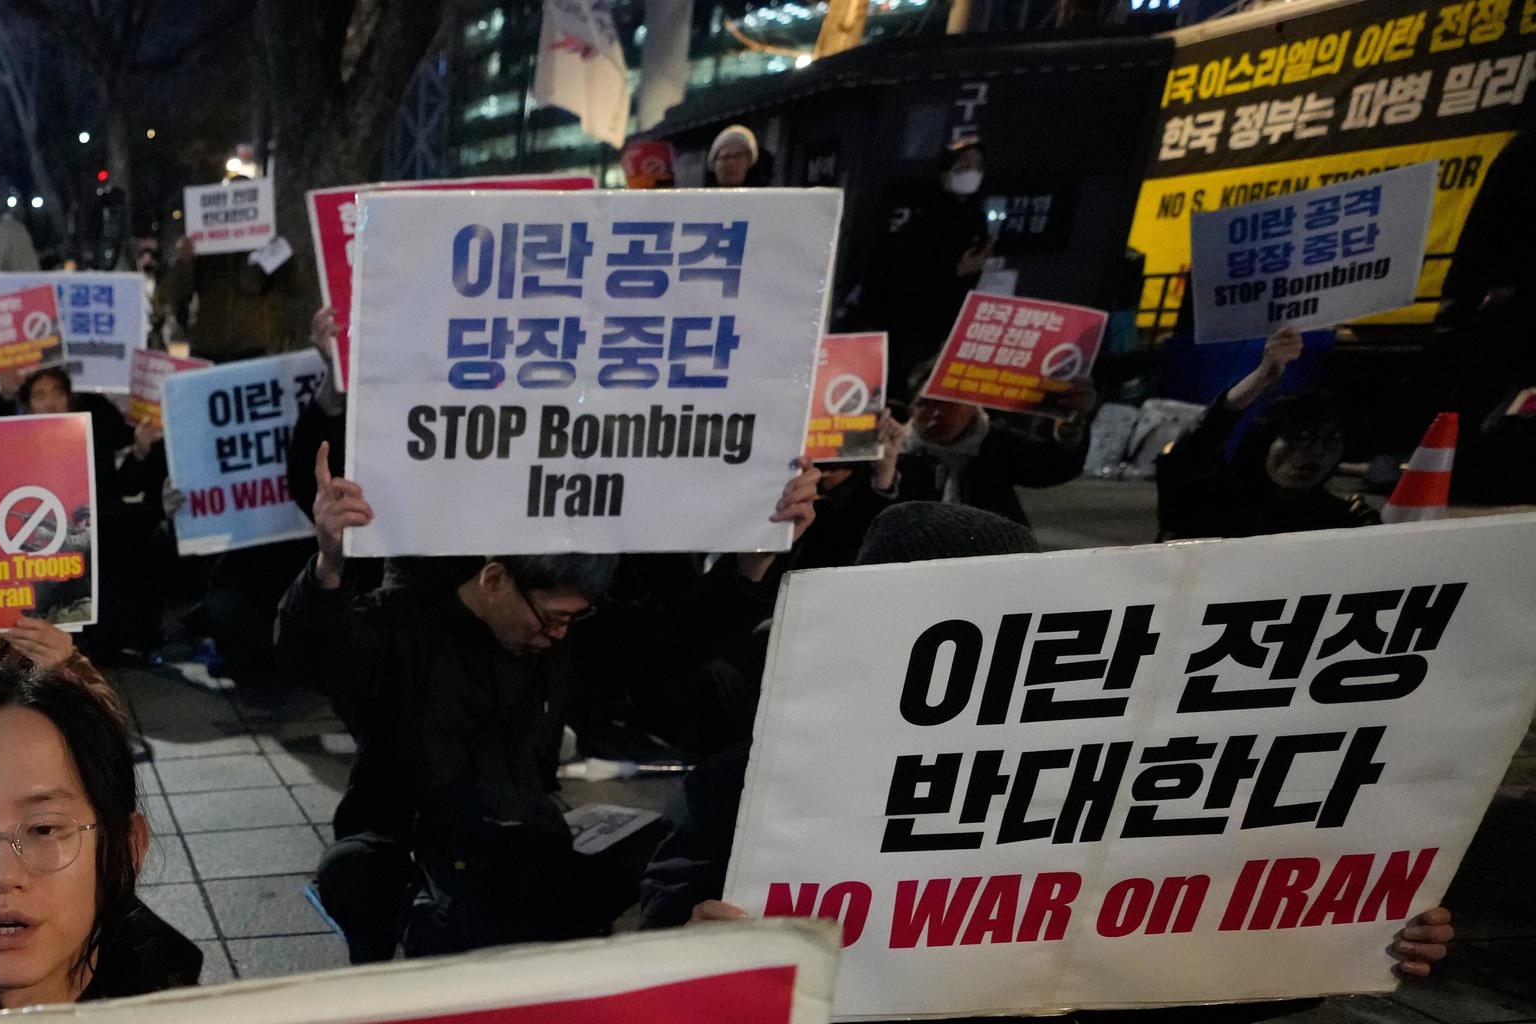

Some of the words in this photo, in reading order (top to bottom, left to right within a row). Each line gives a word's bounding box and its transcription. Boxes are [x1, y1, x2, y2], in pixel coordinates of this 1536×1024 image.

[1352, 10, 1427, 69] 이란
[1429, 0, 1511, 54] 전쟁
[1158, 109, 1226, 161] 한국
[1228, 92, 1335, 151] 정부는
[1340, 69, 1433, 131] 파병
[1436, 50, 1536, 117] 말라
[1156, 191, 1186, 221] NO
[1437, 155, 1482, 190] OR
[1228, 205, 1296, 245] 이란
[1304, 184, 1383, 231] 공격
[452, 220, 593, 300] 이란
[605, 220, 749, 299] 공격
[1227, 241, 1295, 279] 당장
[1302, 222, 1380, 266] 중단
[1214, 280, 1267, 307] STOP
[1272, 257, 1391, 299] Bombing
[1268, 298, 1319, 323] Iran
[447, 316, 587, 390] 당장
[597, 315, 740, 389] 중단
[208, 379, 284, 427] 이란
[407, 405, 527, 460] STOP
[538, 404, 756, 464] Bombing
[190, 487, 226, 518] NO
[526, 465, 625, 518] Iran
[13, 555, 83, 581] Troops
[899, 604, 1160, 727] 이란
[1177, 582, 1467, 714] 전쟁
[881, 726, 1386, 853] 반대한다
[764, 880, 872, 949] NO
[888, 872, 1082, 950] WAR
[1096, 874, 1211, 938] on
[1219, 847, 1439, 933] IRAN
